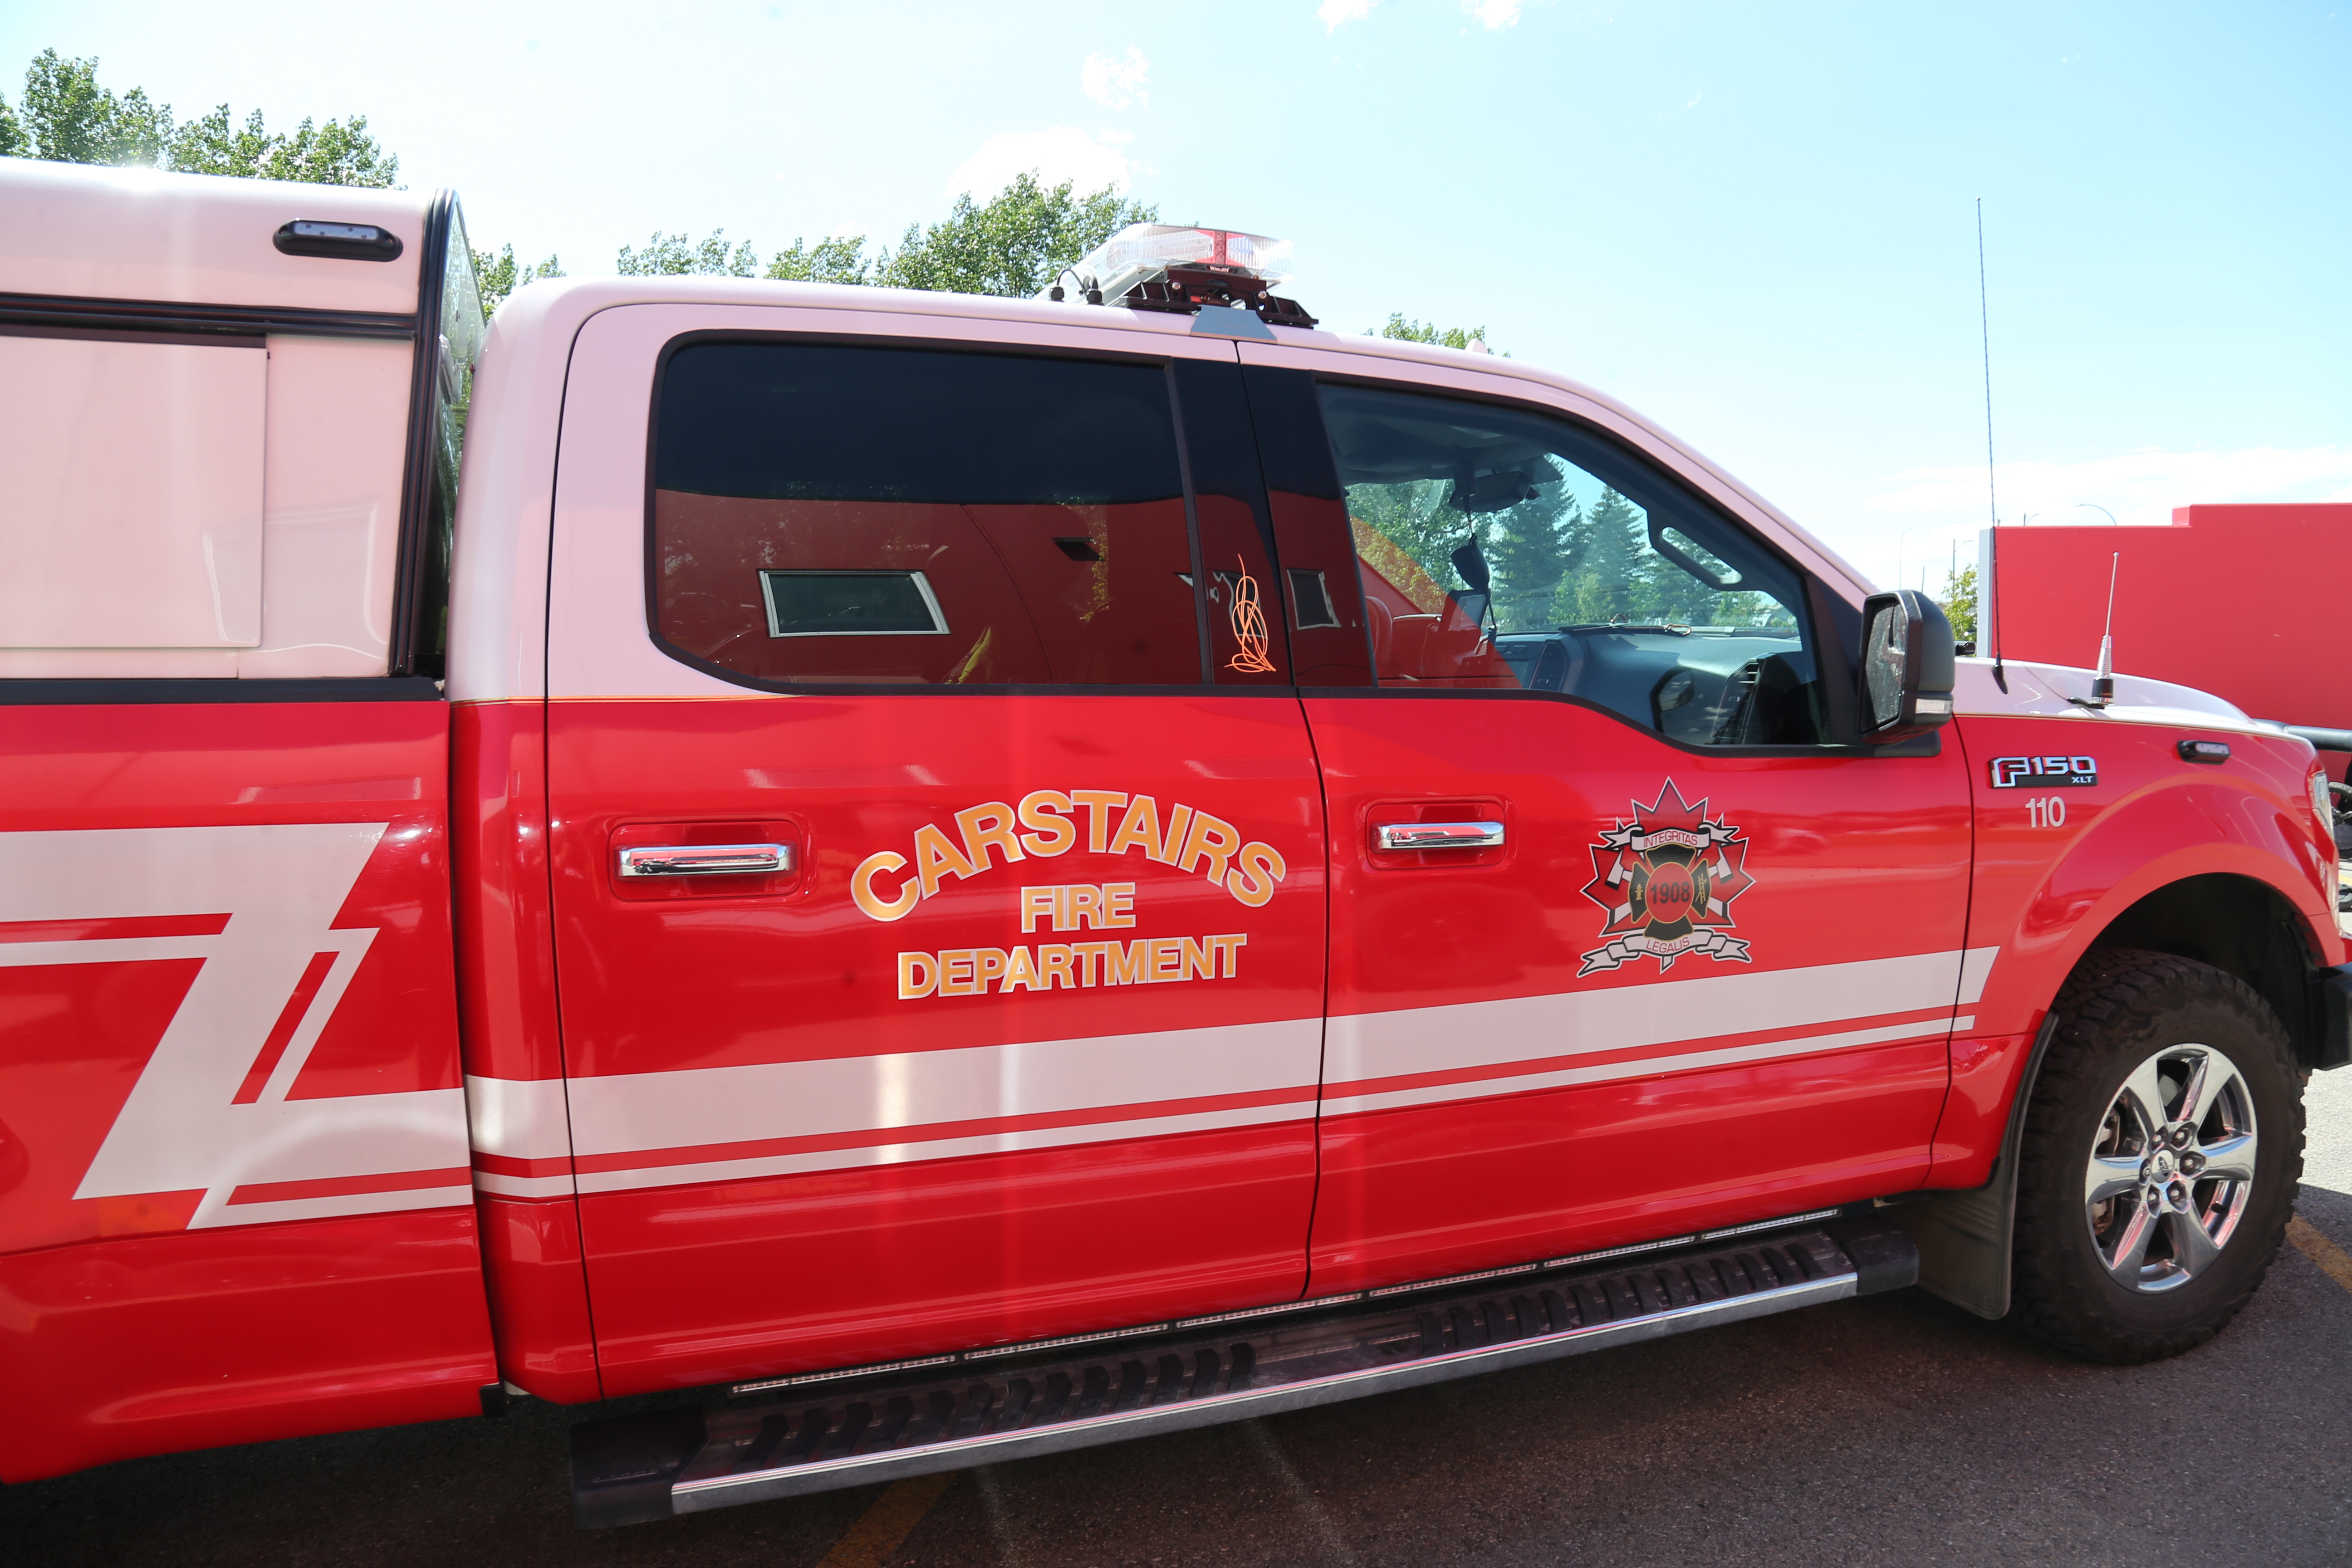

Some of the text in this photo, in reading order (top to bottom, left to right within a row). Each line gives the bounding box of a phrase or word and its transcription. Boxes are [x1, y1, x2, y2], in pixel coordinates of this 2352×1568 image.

[2071, 776, 2093, 784] XLT
[2025, 796, 2066, 828] 110
[1643, 830, 1698, 848] INTEGRITAS
[851, 789, 1286, 922] CARSTAIRS
[1650, 881, 1691, 904] 1908
[1021, 882, 1136, 933] FIRE
[1646, 936, 1690, 954] LEGALIS
[898, 933, 1248, 1000] DEPARTMENT
